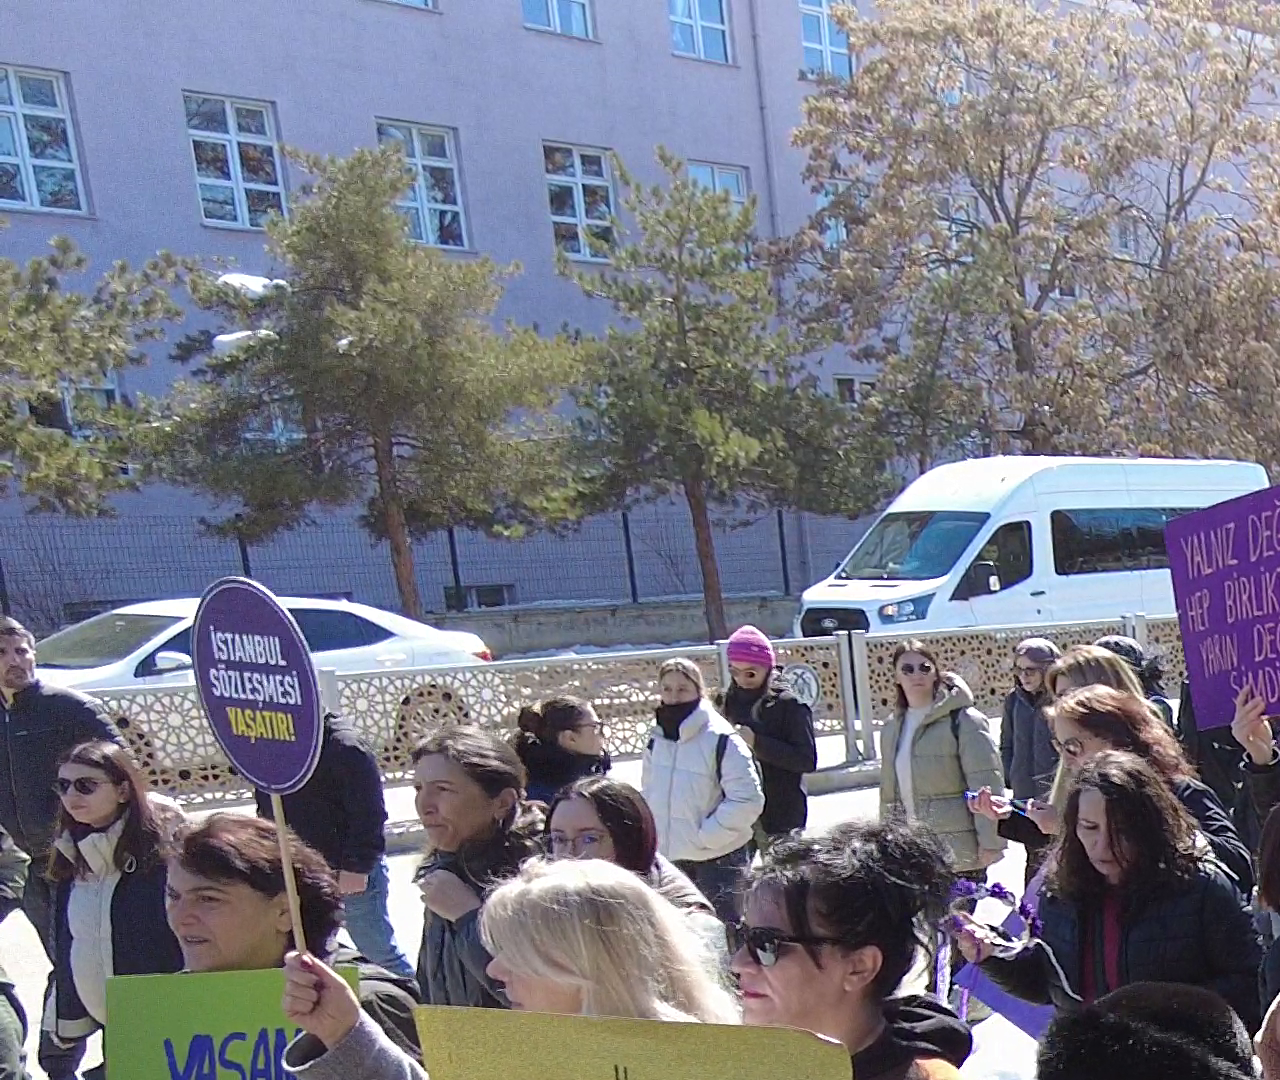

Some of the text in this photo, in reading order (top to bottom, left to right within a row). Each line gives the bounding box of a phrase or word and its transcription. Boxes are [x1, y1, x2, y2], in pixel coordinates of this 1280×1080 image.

[1181, 522, 1239, 580] YALNIZ
[1186, 588, 1210, 633] HEP
[210, 625, 287, 667] İSTANBUL
[1199, 634, 1239, 679] YARIN
[209, 663, 302, 708] SÖZLEŞMESİ
[226, 706, 296, 744] YAŞATIR!
